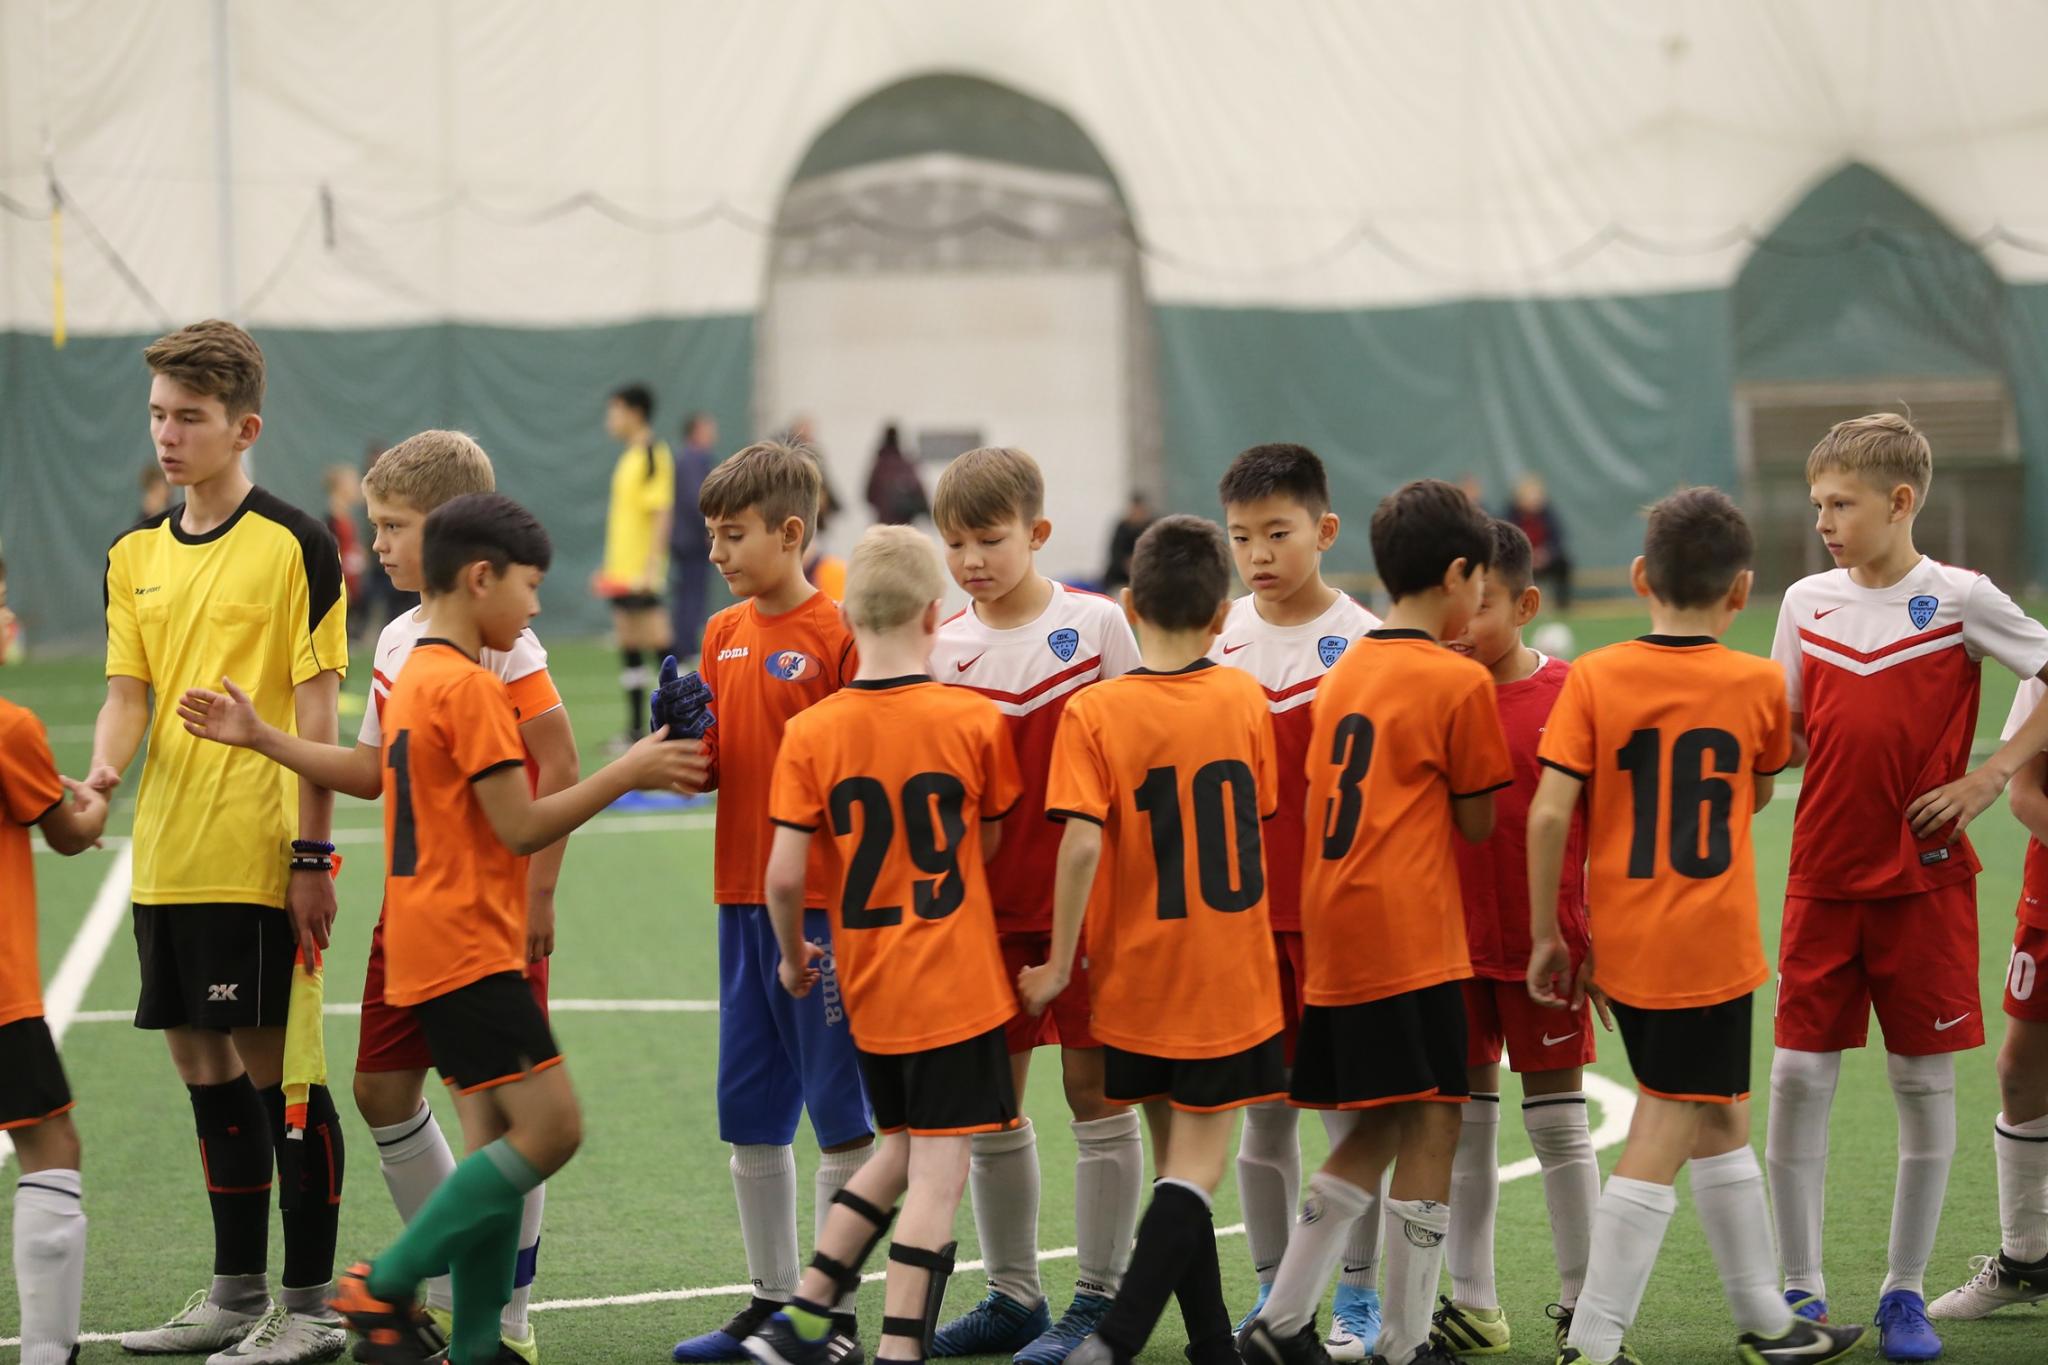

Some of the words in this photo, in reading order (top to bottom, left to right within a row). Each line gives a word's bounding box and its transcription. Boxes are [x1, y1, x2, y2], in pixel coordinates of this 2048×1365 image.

[387, 729, 418, 877] 1
[829, 772, 967, 930] 29
[1134, 758, 1265, 921] 10
[1322, 712, 1375, 860] 3
[1616, 727, 1741, 880] 16
[207, 983, 239, 1001] 2K
